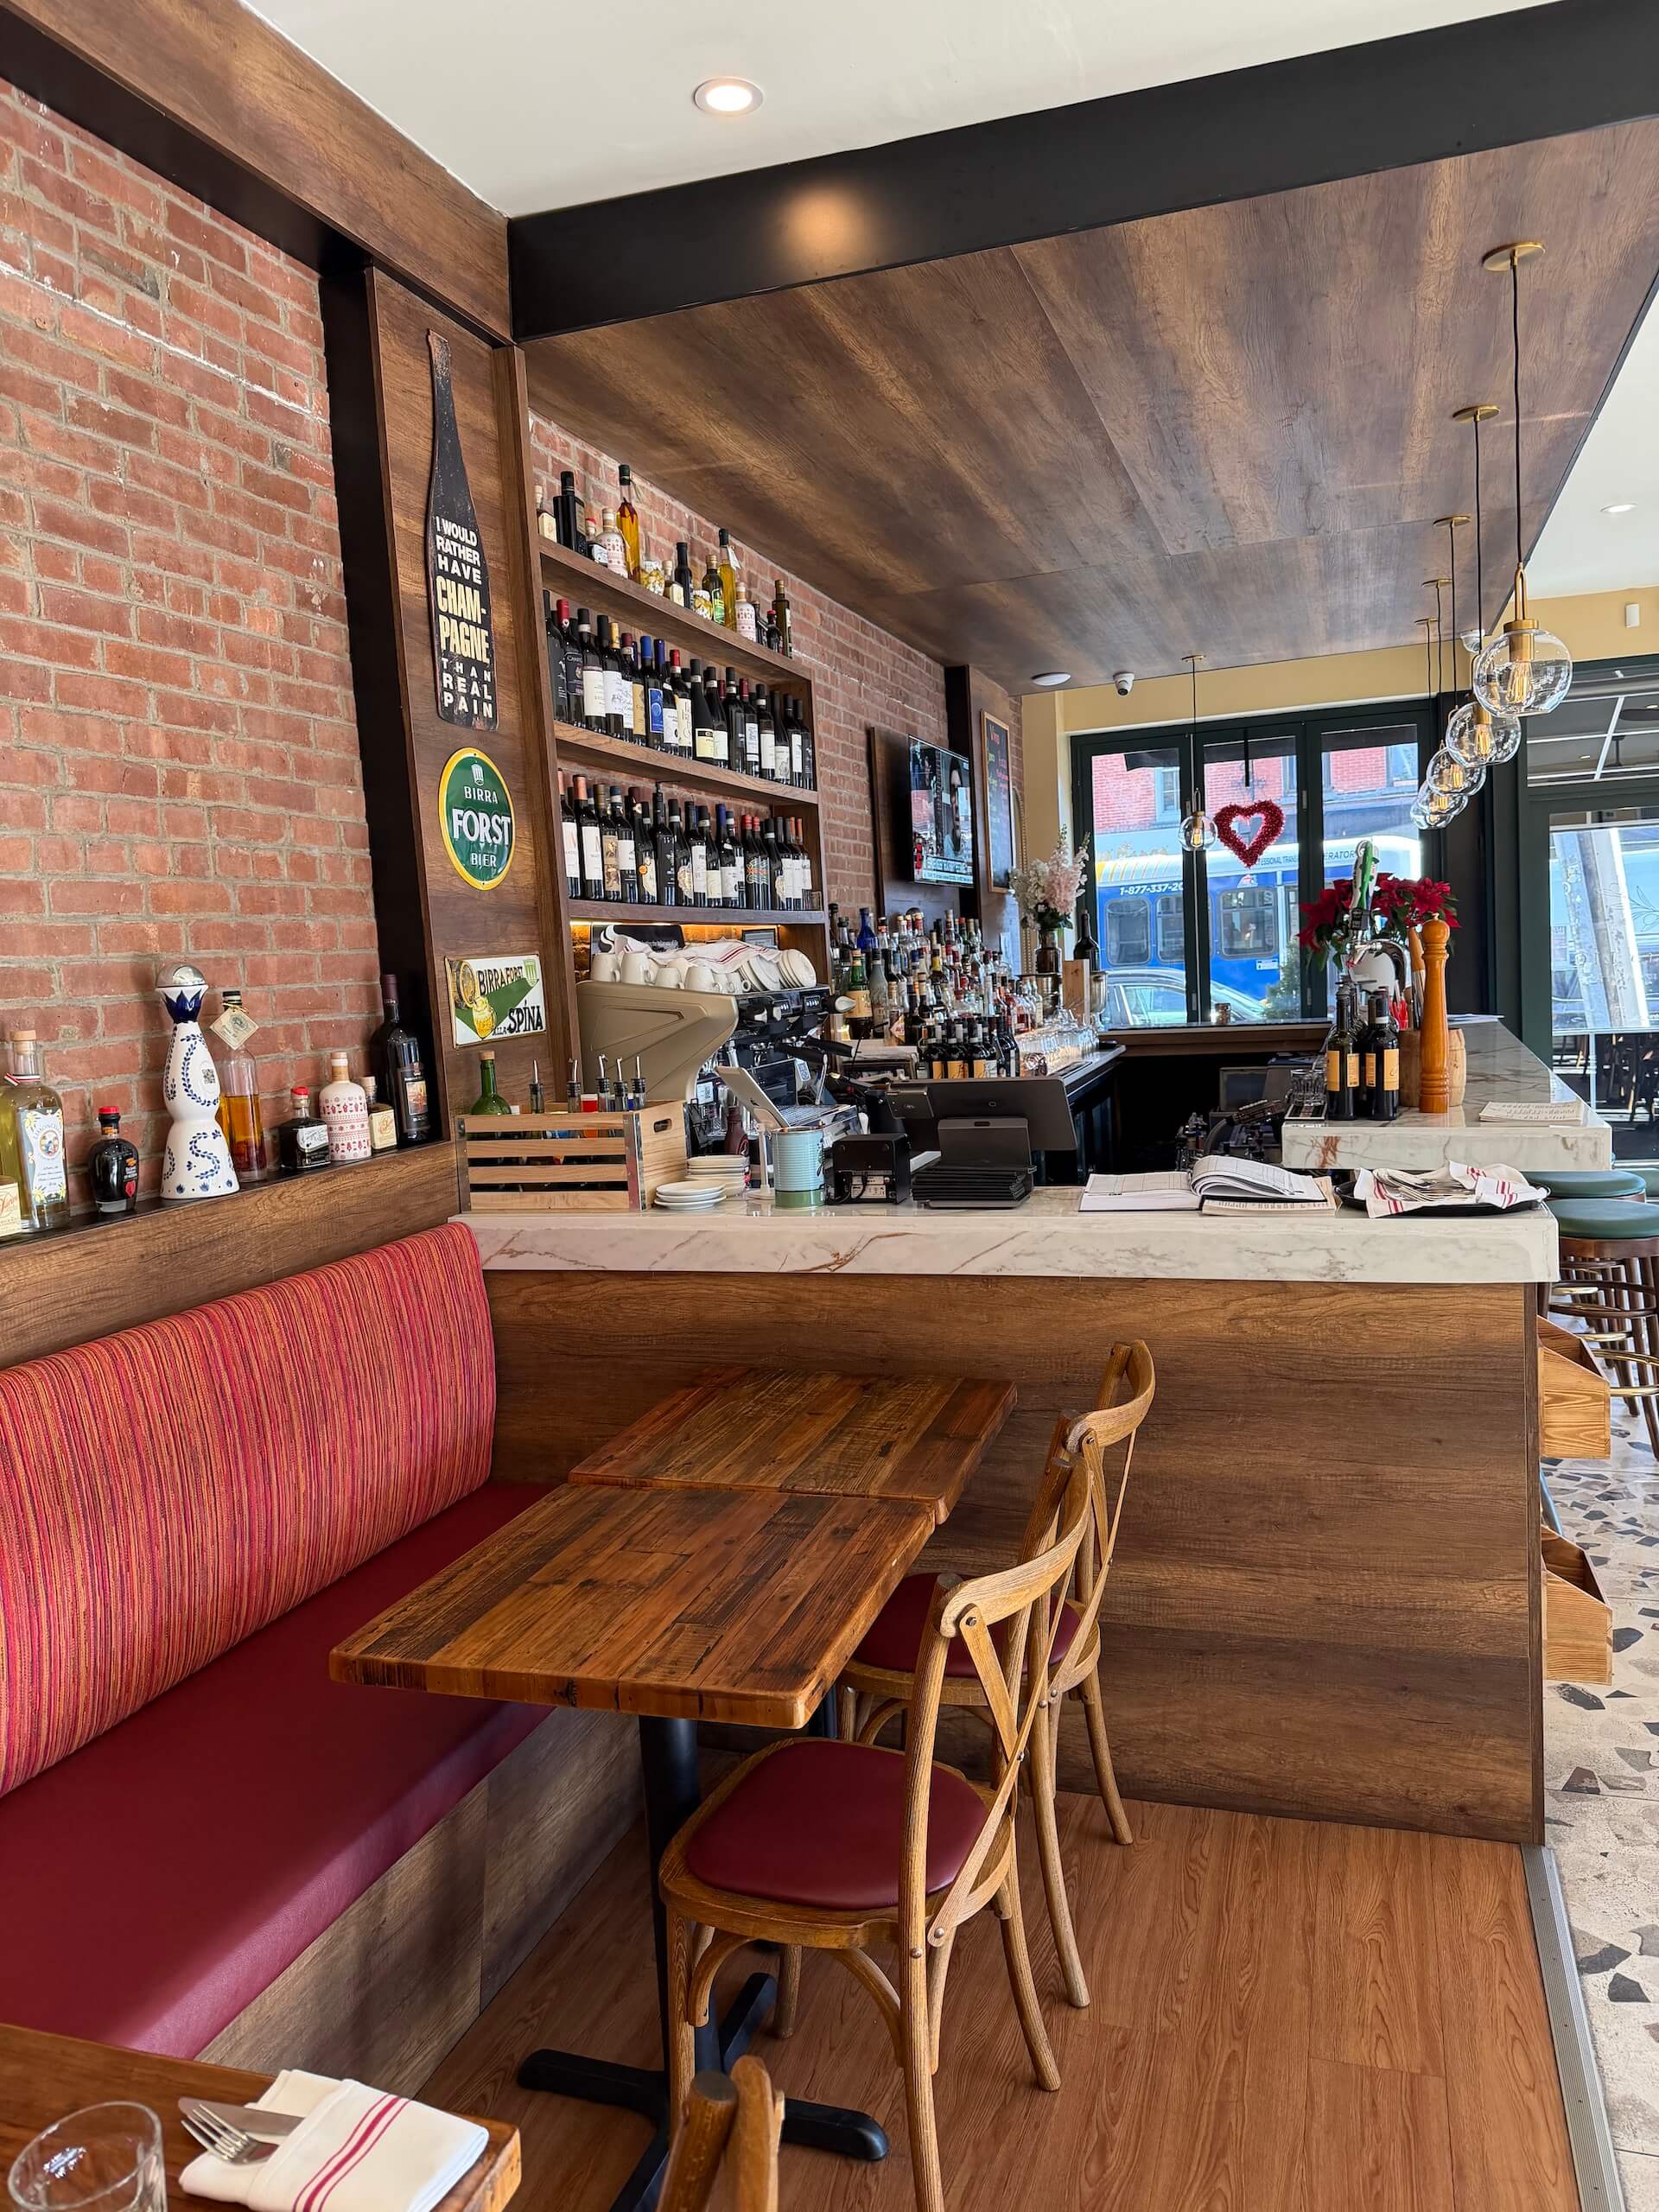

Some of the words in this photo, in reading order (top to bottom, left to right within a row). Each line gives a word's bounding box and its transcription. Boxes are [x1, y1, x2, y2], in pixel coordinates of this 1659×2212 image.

[435, 516, 441, 532] I
[442, 518, 478, 547] WOULD
[435, 534, 481, 568] RATHER
[437, 553, 482, 585] HAVE
[436, 575, 486, 625] CHAM-
[438, 613, 490, 664] PAGNE
[442, 658, 492, 683] THAN
[442, 672, 493, 701] REAL
[443, 691, 493, 719] PAIN
[463, 785, 499, 804] BIRRA
[452, 808, 512, 847] FORST
[470, 852, 498, 868] BIER
[477, 968, 507, 996] BIRRA
[505, 965, 524, 983] FORST
